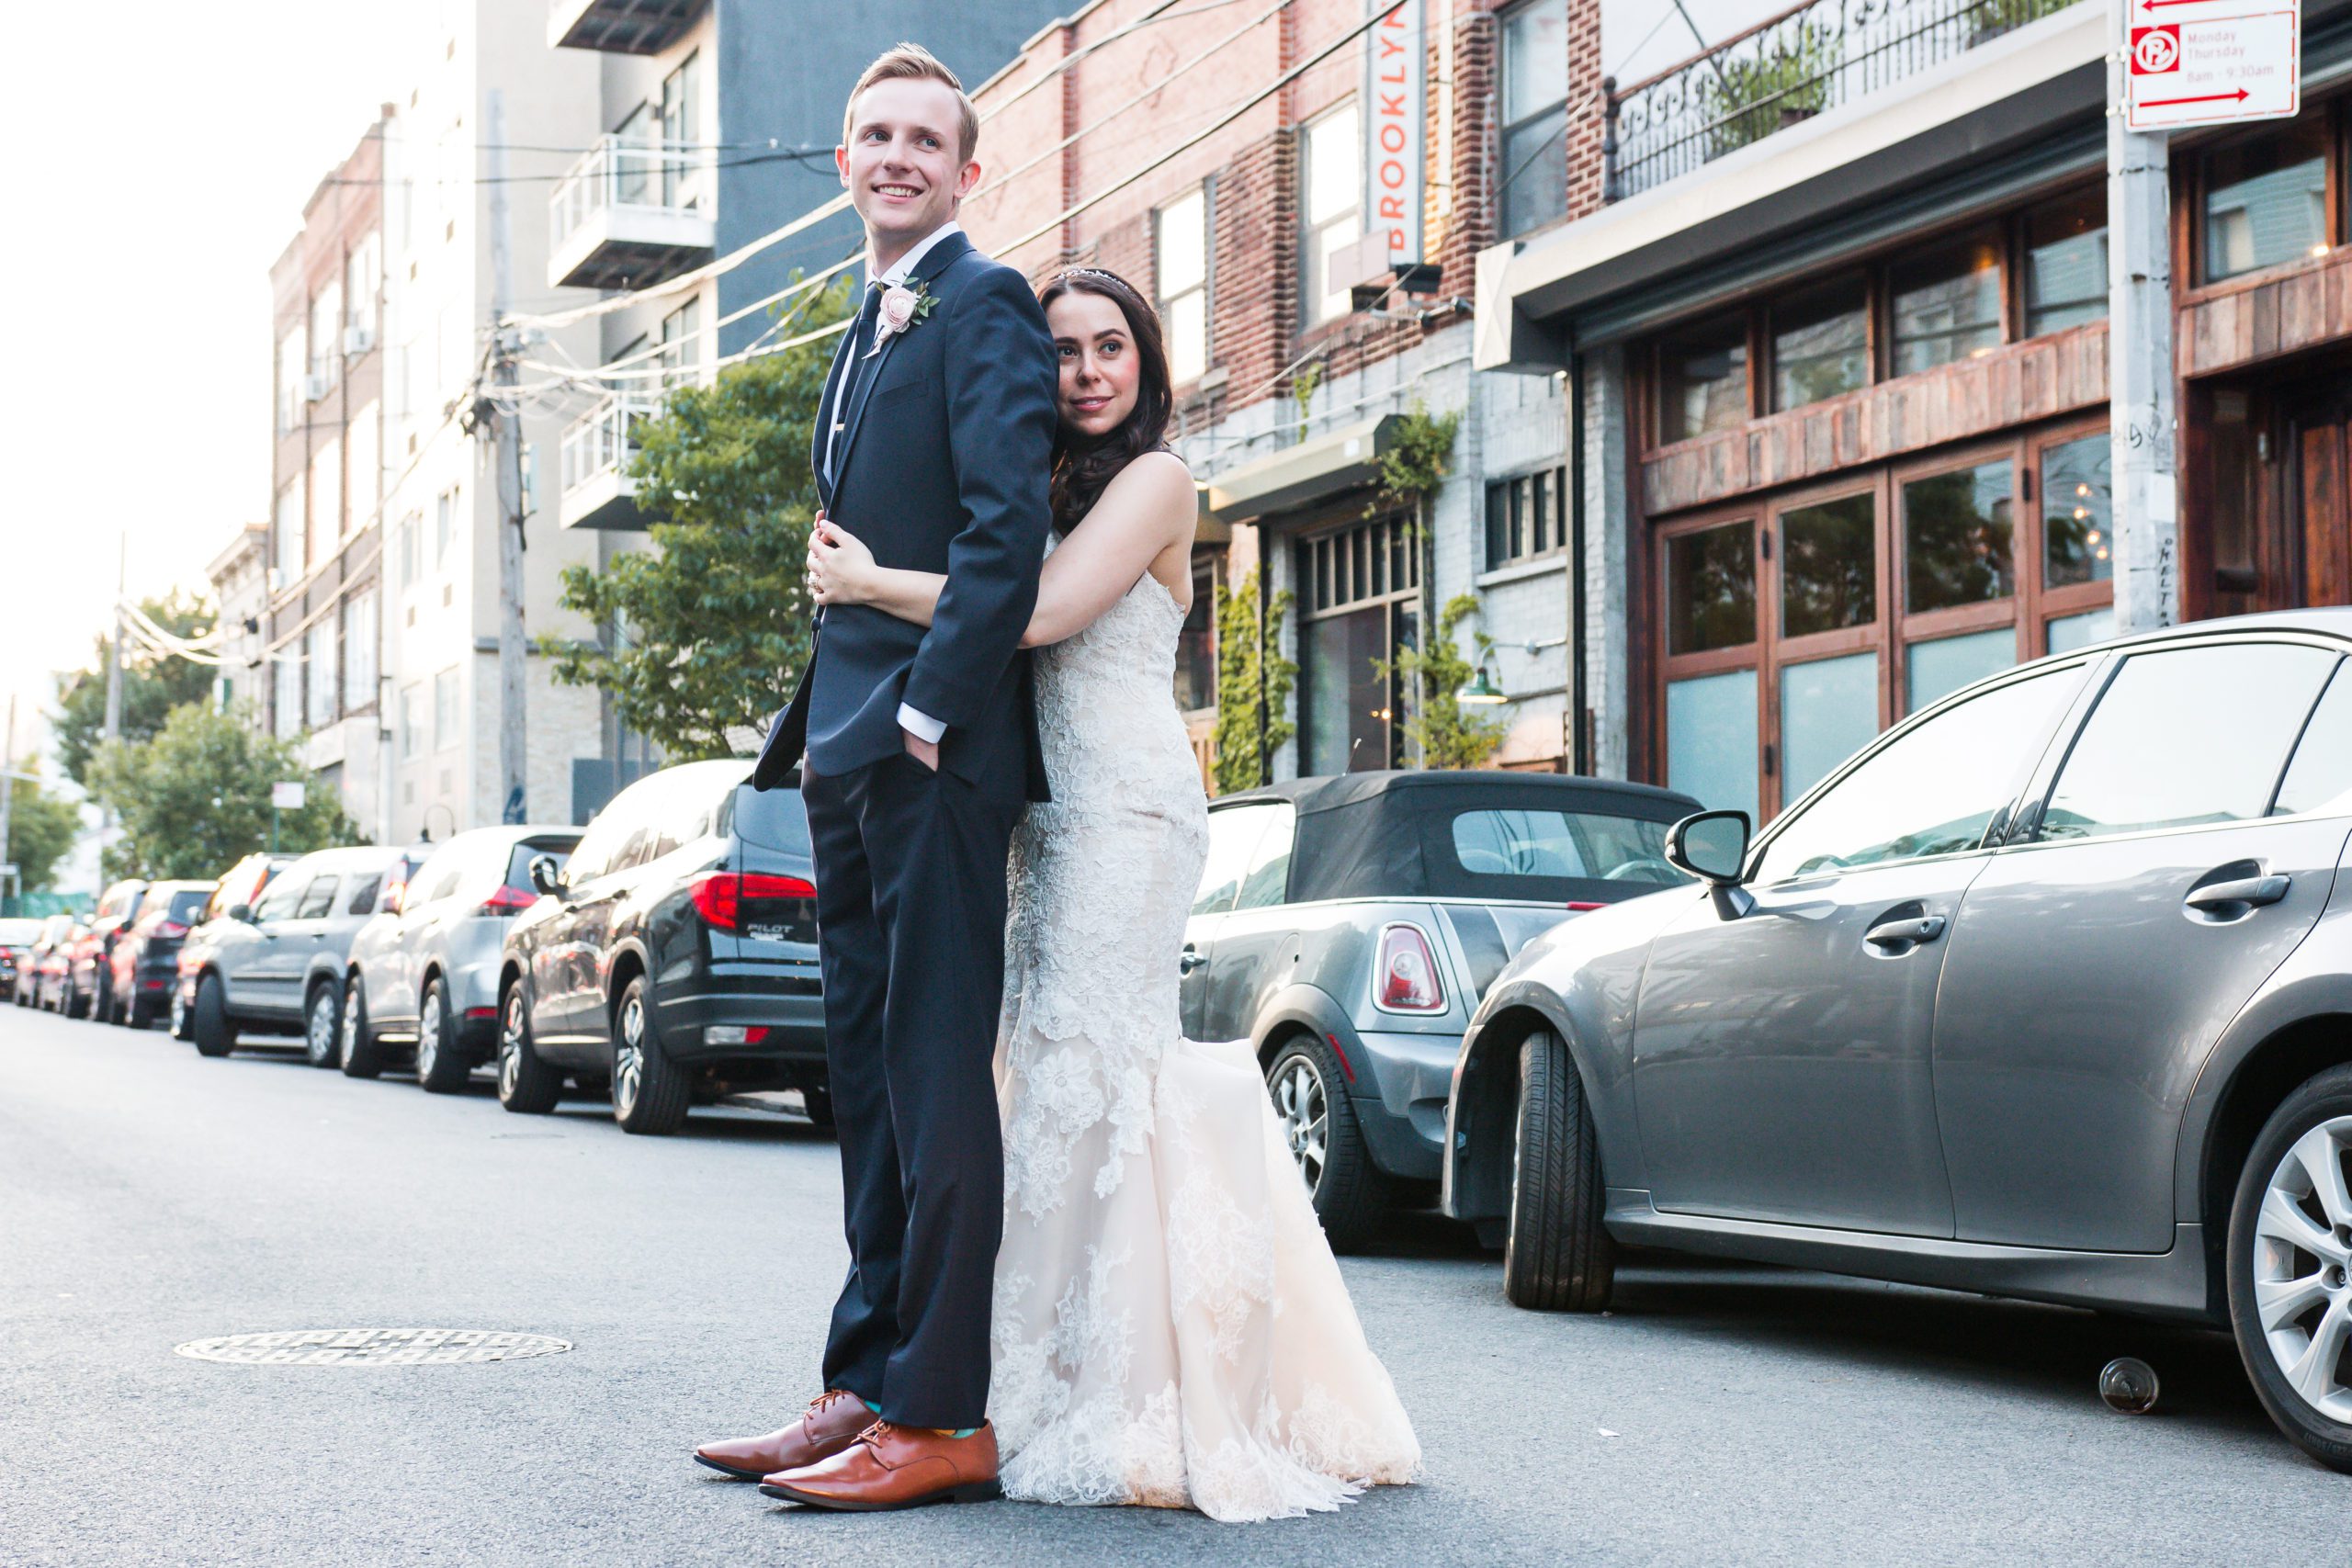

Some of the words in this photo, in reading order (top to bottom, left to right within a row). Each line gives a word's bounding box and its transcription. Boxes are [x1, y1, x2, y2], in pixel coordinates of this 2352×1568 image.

[2188, 31, 2237, 45] Monday
[2188, 46, 2245, 60] Thursday
[2187, 71, 2213, 84] 8am
[746, 923, 795, 933] PILOT
